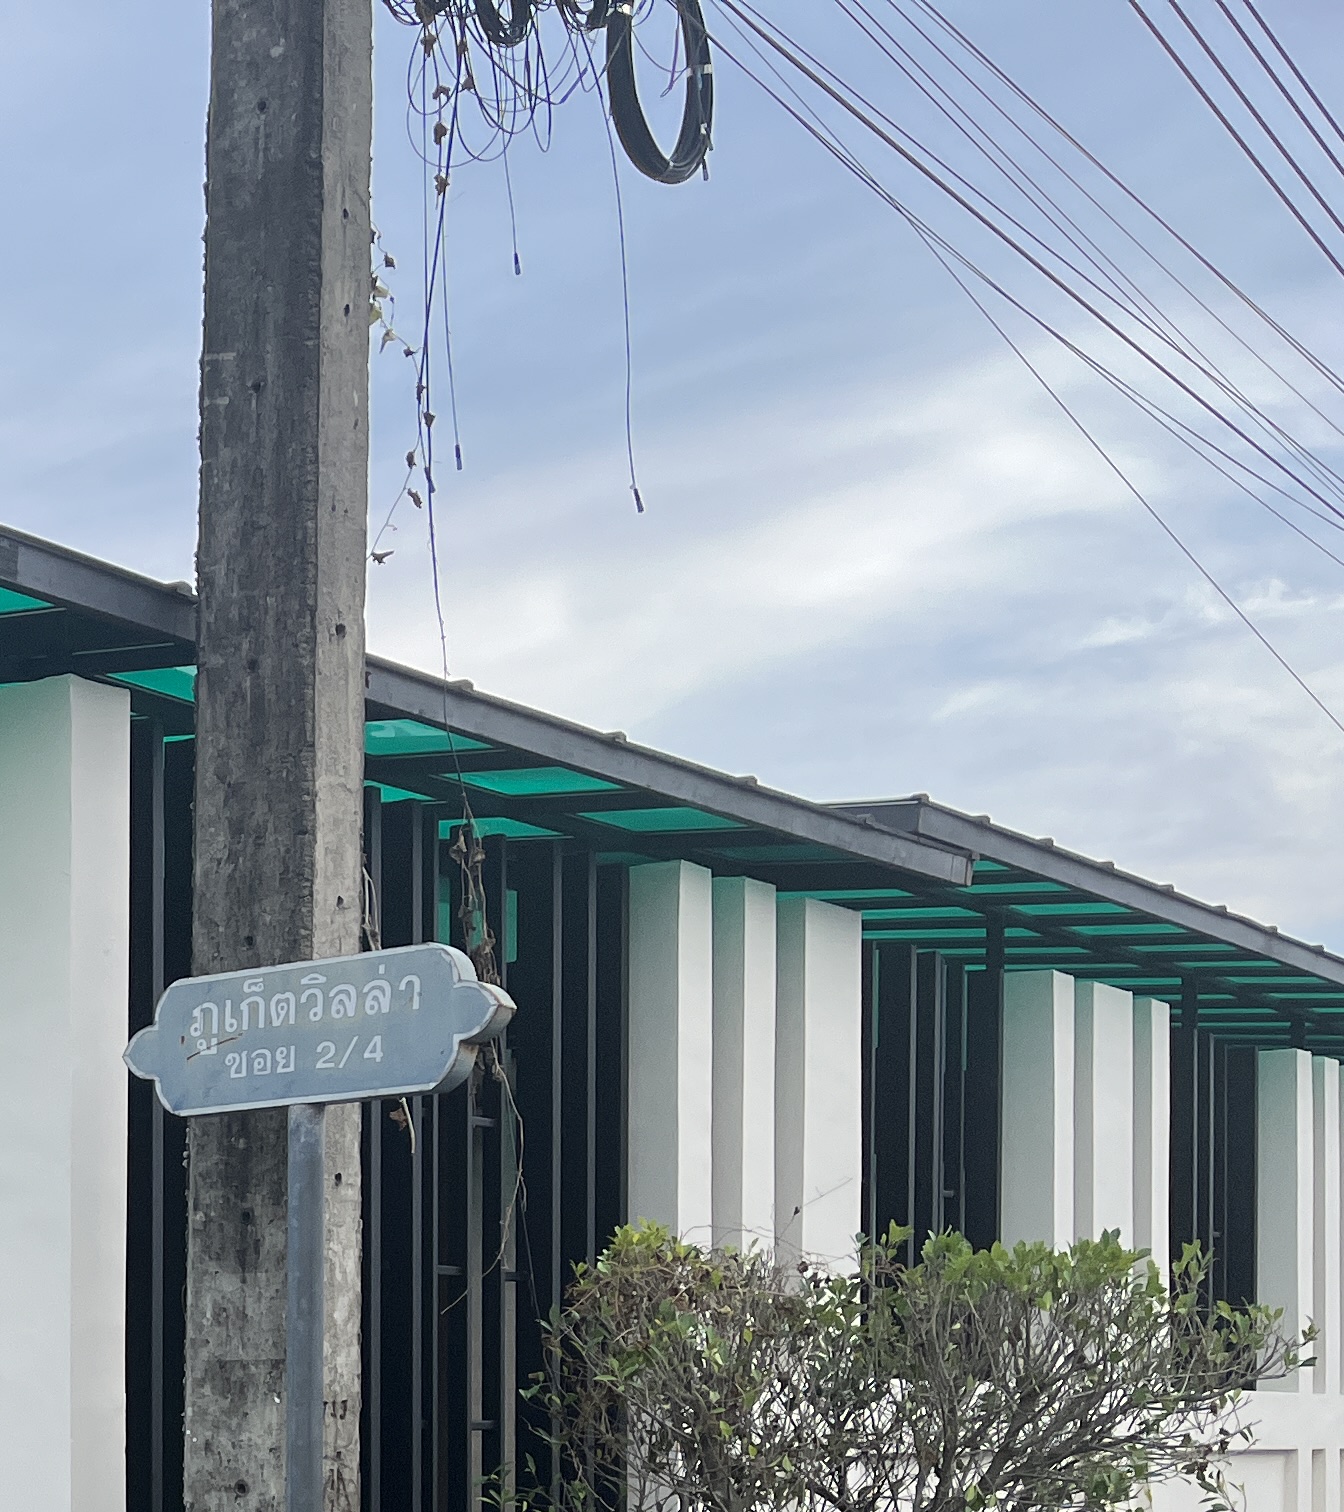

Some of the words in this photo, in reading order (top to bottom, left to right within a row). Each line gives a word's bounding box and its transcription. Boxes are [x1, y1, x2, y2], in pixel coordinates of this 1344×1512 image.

[189, 963, 422, 1056] ภูเก็ตวิลล่า
[224, 1044, 296, 1079] ซอย
[314, 1034, 384, 1070] 2/4
